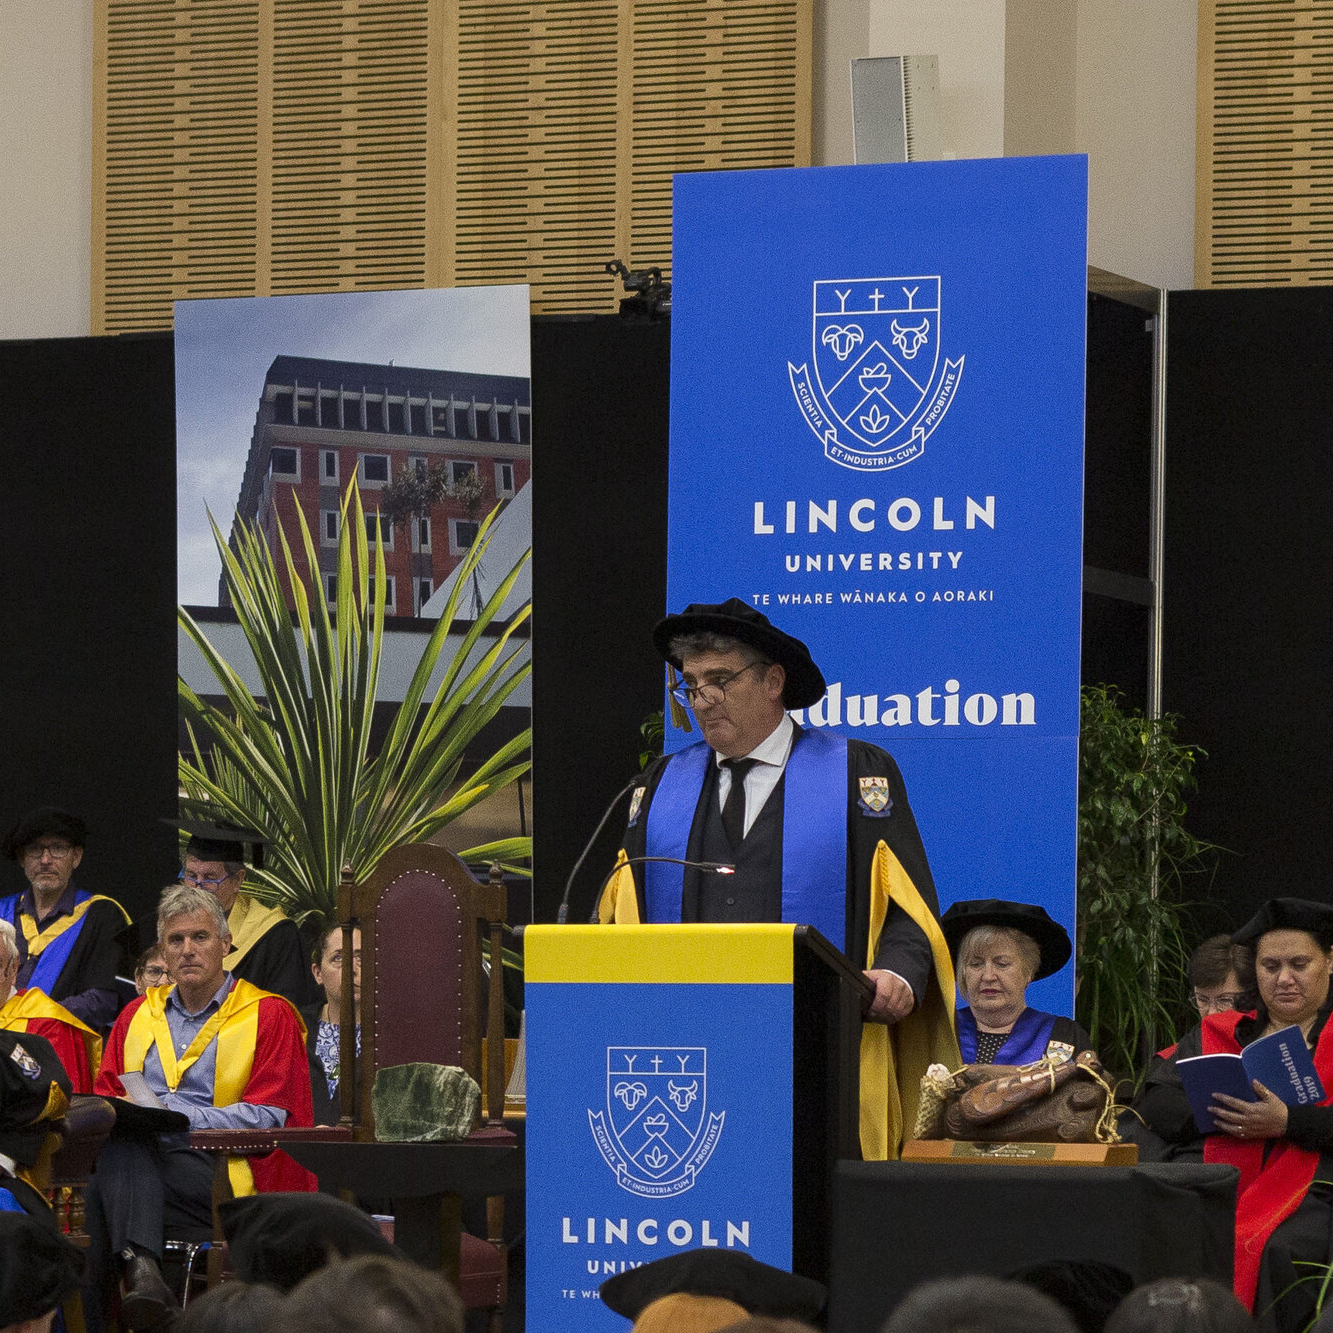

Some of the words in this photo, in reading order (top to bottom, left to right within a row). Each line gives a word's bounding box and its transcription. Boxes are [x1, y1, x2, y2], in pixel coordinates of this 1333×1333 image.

[797, 381, 823, 429] SCIENTIA
[924, 373, 956, 426] PROBITATE
[754, 496, 995, 535] LINCOLN
[785, 551, 963, 573] UNIVERSITY
[753, 594, 770, 605] TE
[778, 592, 833, 605] WHARE
[840, 589, 908, 604] WĀNAKA
[915, 591, 926, 603] O
[932, 590, 995, 602] AORAKI
[787, 679, 1037, 728] duation
[1279, 1042, 1308, 1104] Graduation
[1303, 1075, 1320, 1100] 2019
[595, 1125, 616, 1163] SCIENTIA
[695, 1124, 719, 1164] PROBITATE
[562, 1217, 750, 1248] LINCOLN
[562, 1289, 576, 1299] TE
